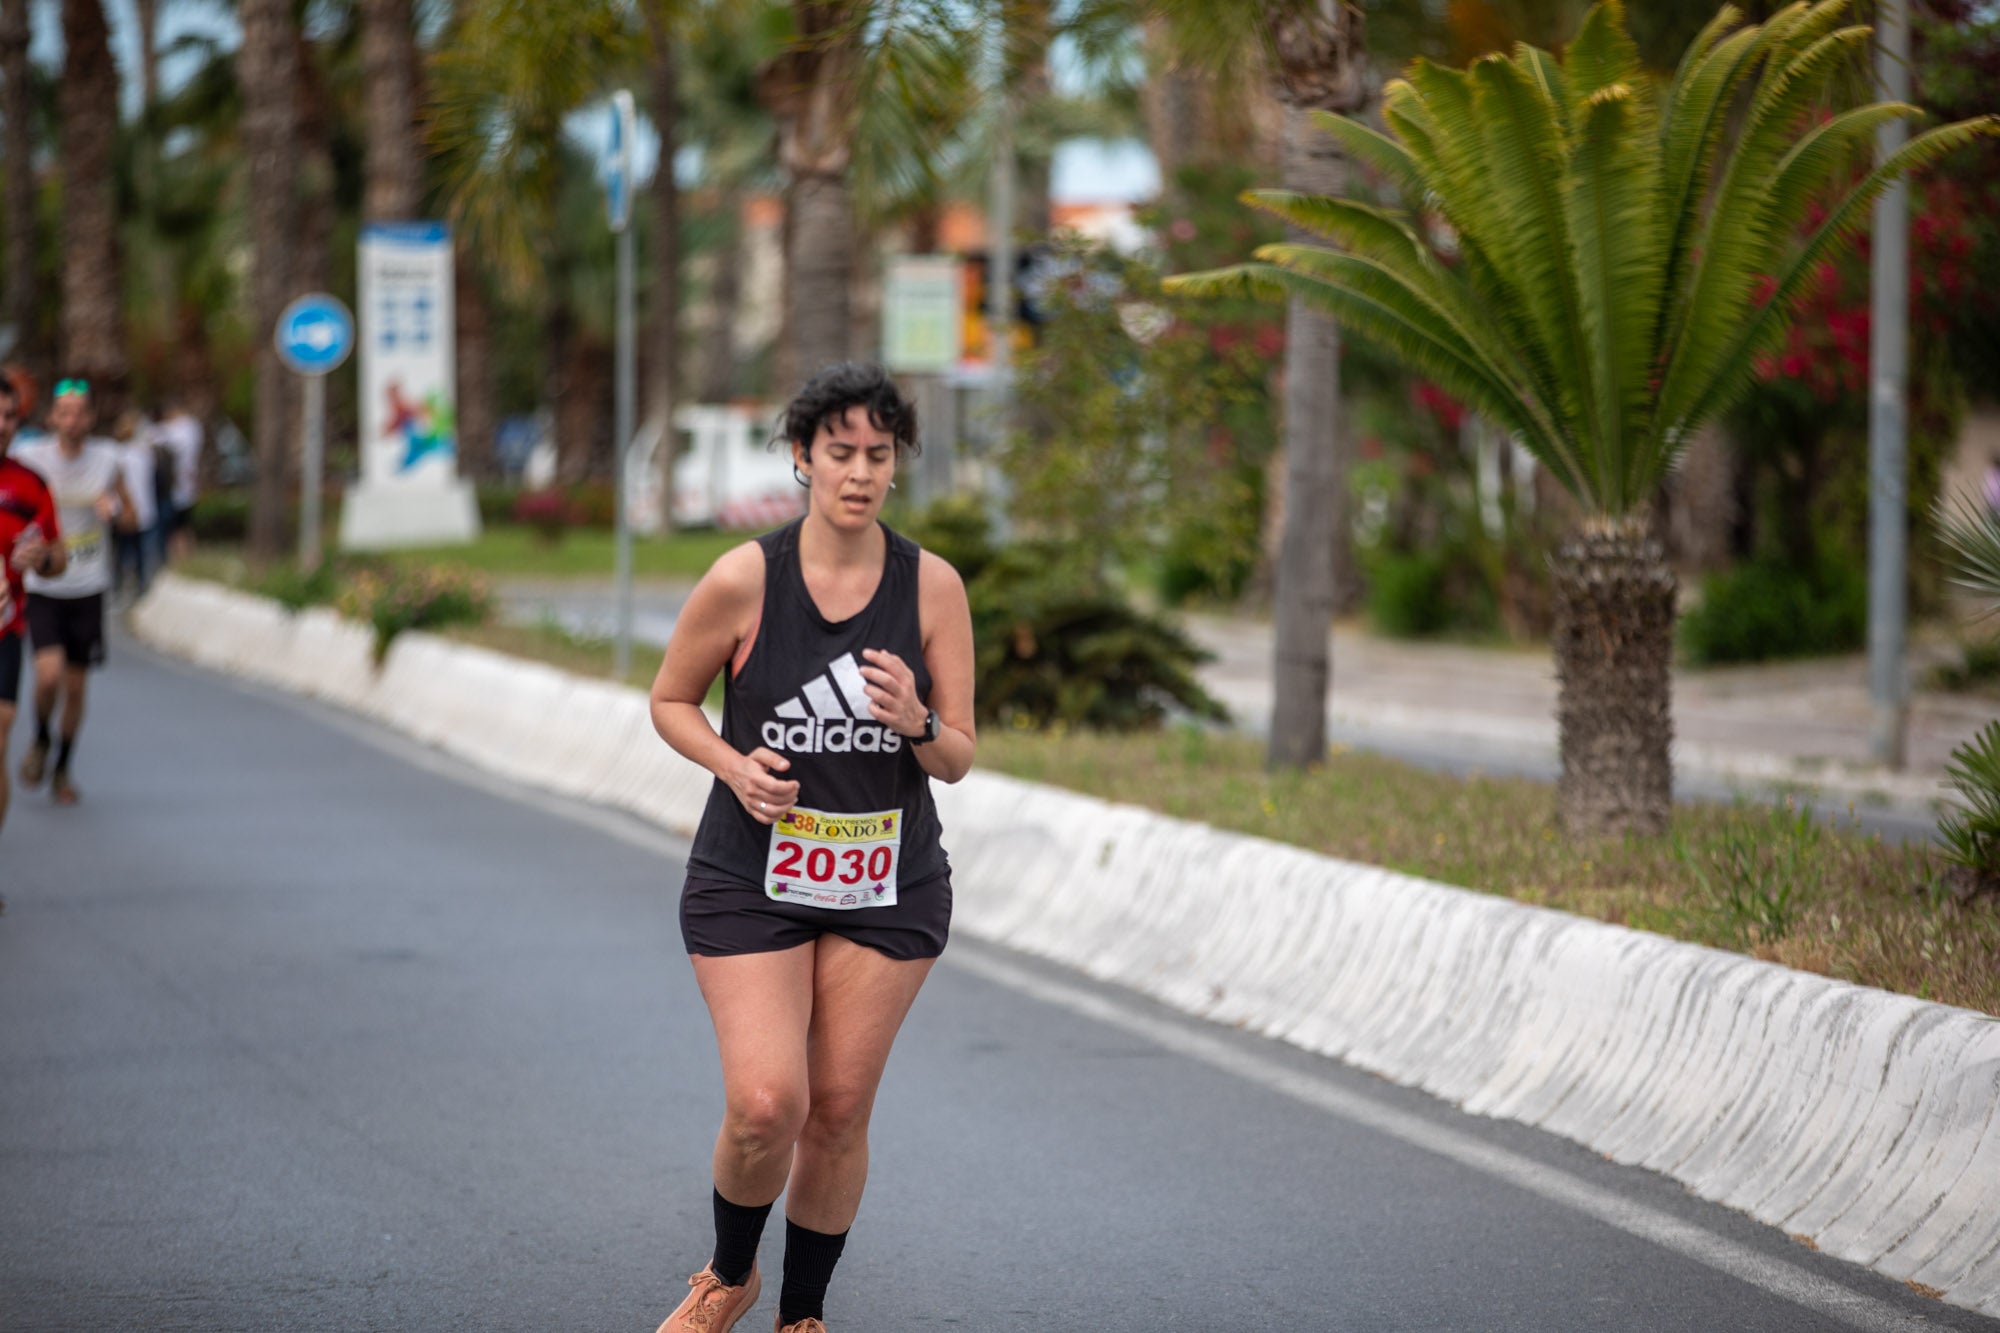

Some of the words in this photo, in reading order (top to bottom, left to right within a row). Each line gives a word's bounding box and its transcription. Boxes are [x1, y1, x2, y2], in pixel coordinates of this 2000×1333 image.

[763, 718, 902, 753] adidas
[794, 814, 816, 833] 38
[821, 817, 842, 825] GRAN
[772, 841, 892, 884] 2030
